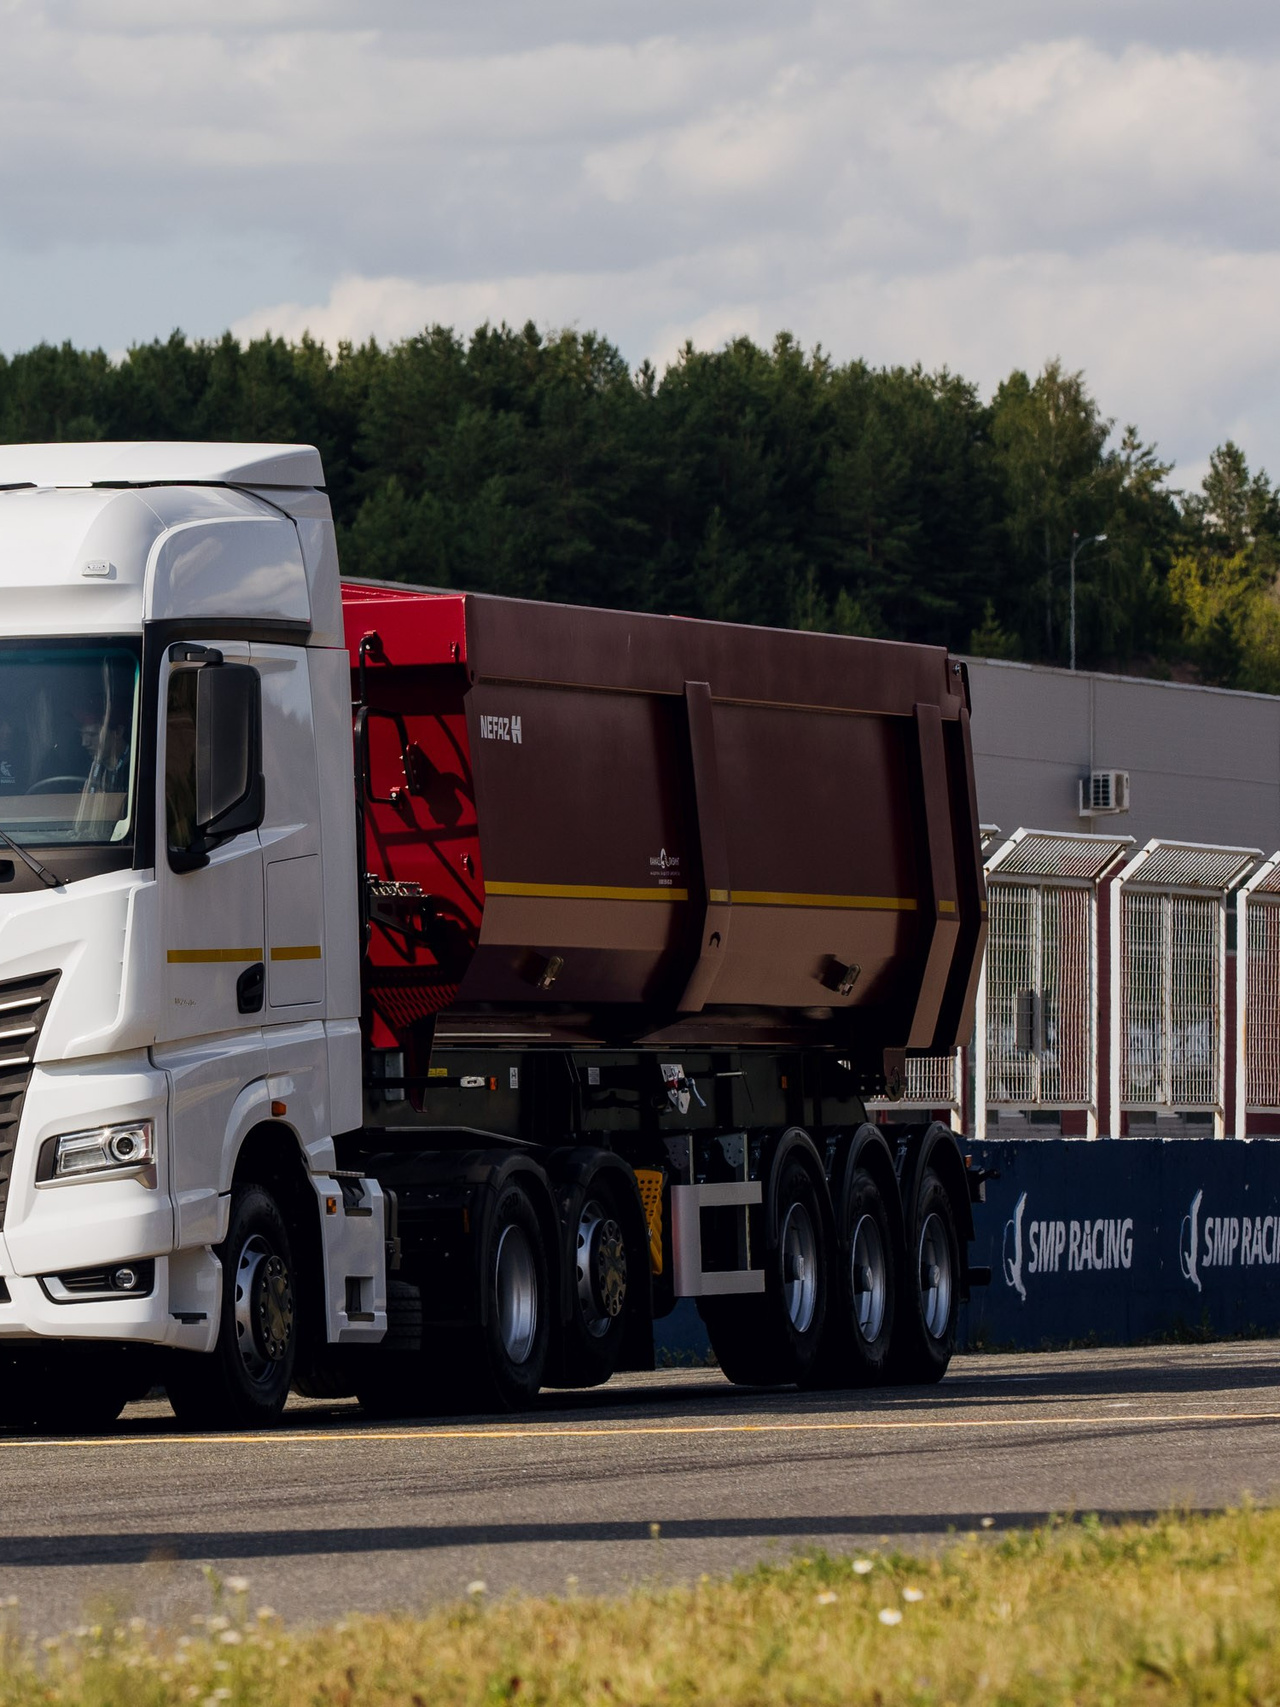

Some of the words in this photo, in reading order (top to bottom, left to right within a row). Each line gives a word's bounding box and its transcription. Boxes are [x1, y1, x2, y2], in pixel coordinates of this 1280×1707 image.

[480, 714, 510, 741] NEFAZ
[1028, 1220, 1066, 1274] SMP
[1068, 1218, 1134, 1270] RACING
[1201, 1217, 1240, 1267] SMP
